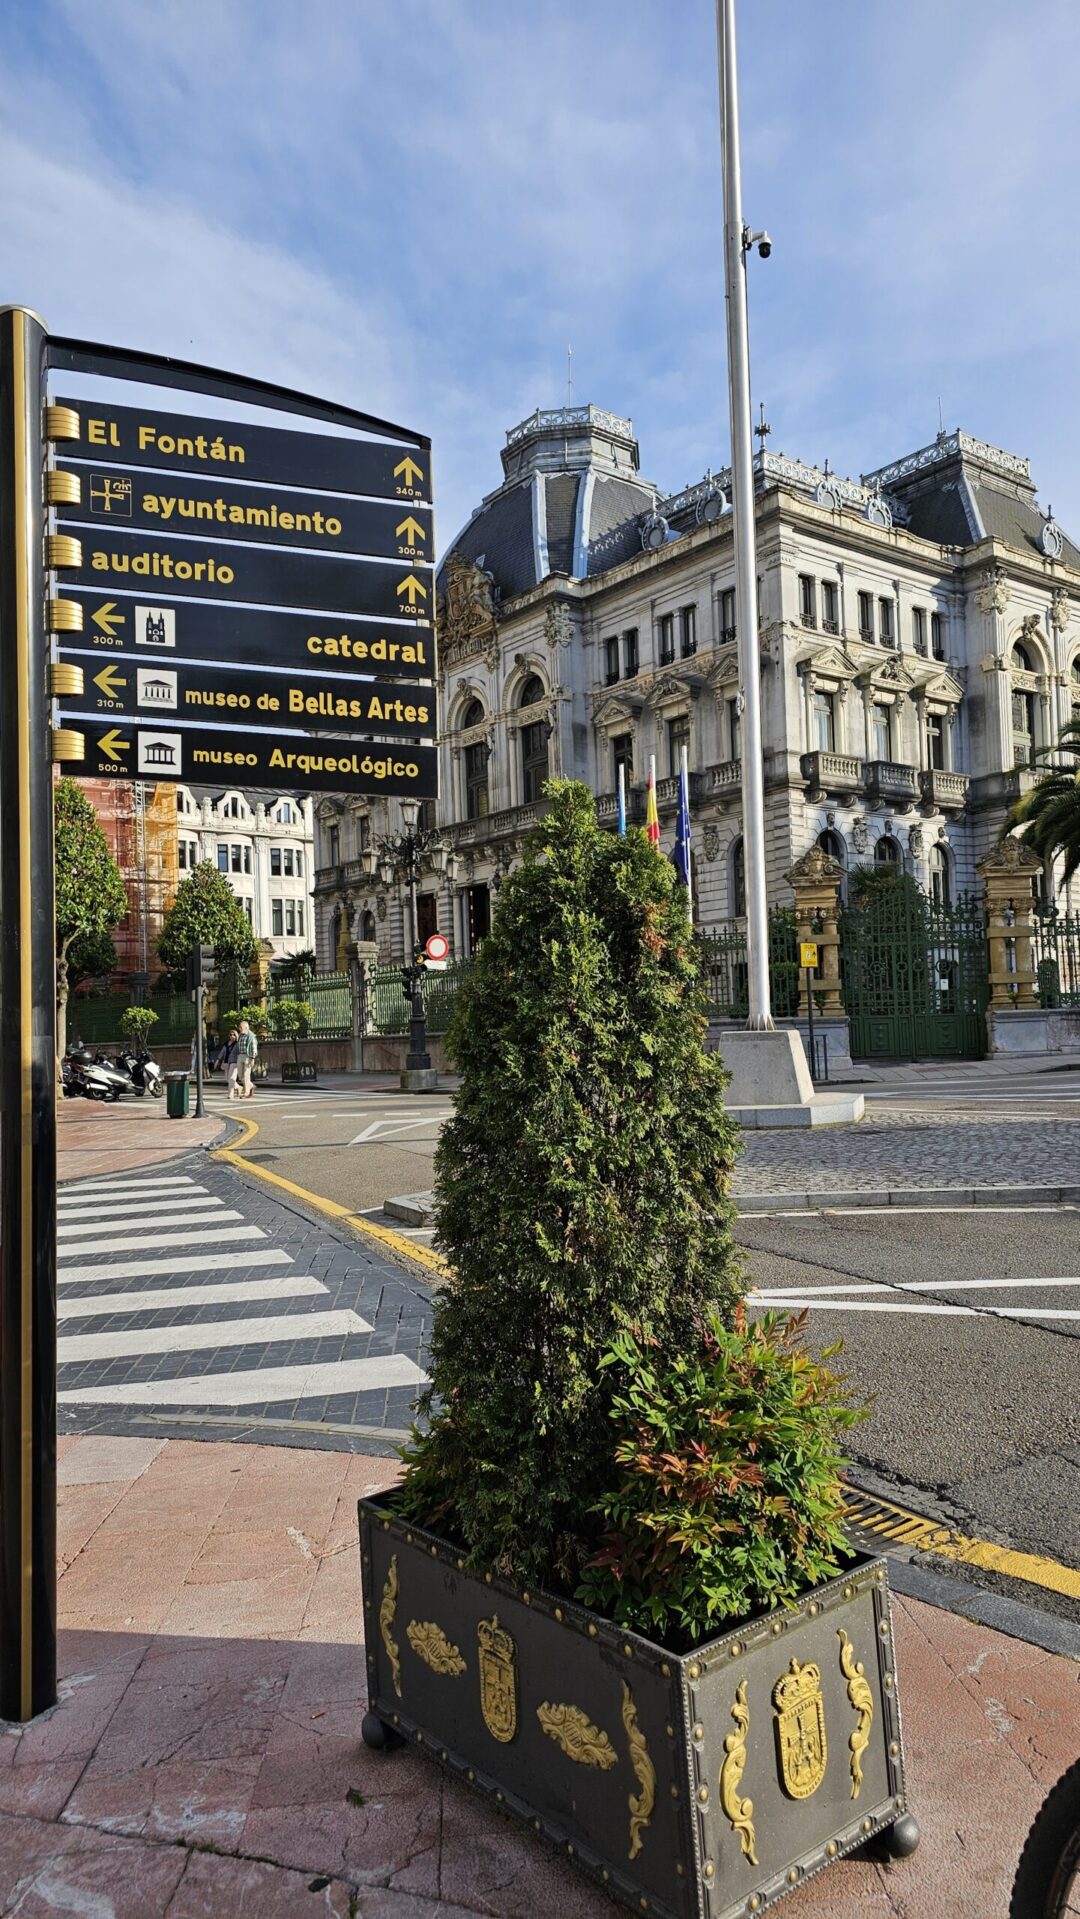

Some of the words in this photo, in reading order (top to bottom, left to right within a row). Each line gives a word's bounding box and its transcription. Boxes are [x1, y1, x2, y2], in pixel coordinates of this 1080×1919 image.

[89, 420, 120, 446] El
[139, 427, 244, 463] Fontán
[396, 487, 413, 495] 340
[142, 494, 342, 536] ayuntamiento
[398, 547, 415, 555] 300
[92, 552, 234, 583] auditorio
[400, 605, 416, 613] 700
[94, 636, 113, 644] 300
[307, 635, 425, 664] catedral
[97, 699, 114, 707] 310
[186, 691, 250, 708] museo
[257, 694, 279, 710] de
[289, 689, 361, 717] Bellas
[368, 697, 428, 723] Artes
[99, 764, 118, 772] 500
[194, 751, 257, 765] museo
[269, 749, 418, 778] Arqueológico
